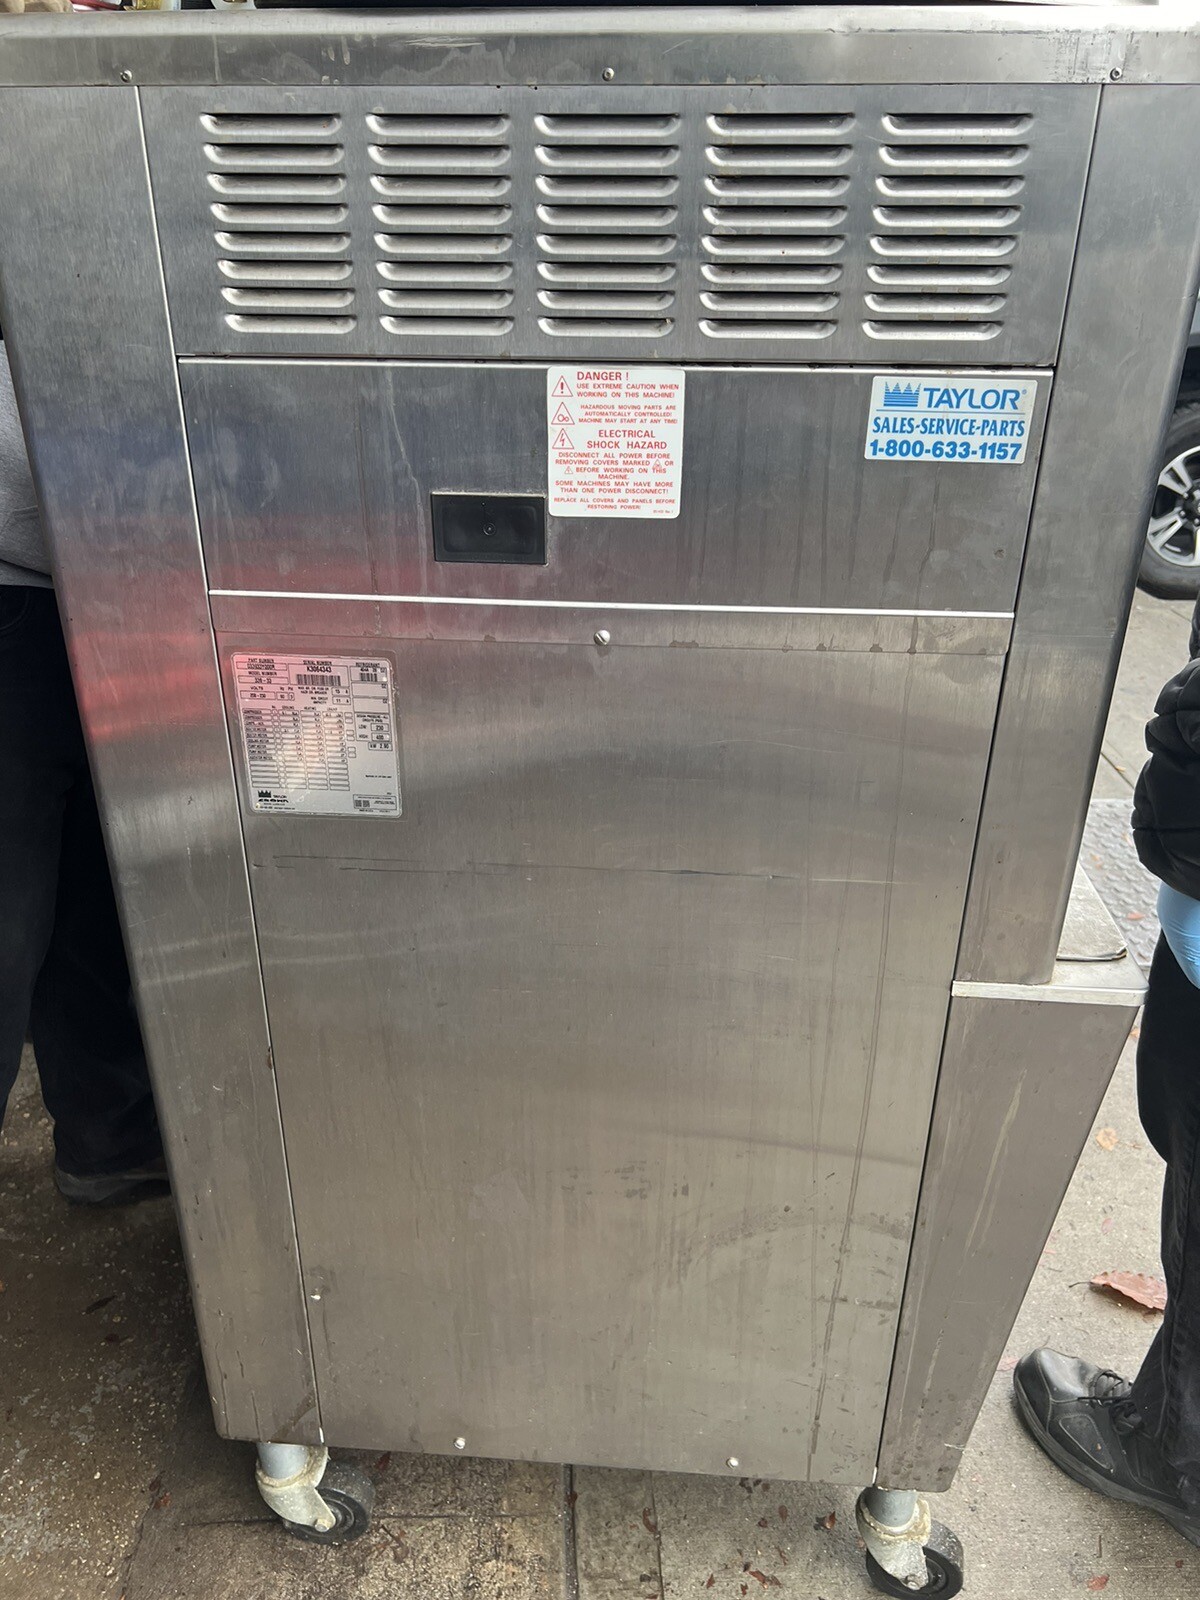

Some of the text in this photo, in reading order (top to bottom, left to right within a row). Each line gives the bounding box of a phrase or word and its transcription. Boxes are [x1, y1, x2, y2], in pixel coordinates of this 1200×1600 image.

[577, 372, 622, 380] DANGER
[924, 388, 1020, 410] TAYLOR
[598, 430, 656, 438] ELECTRICAL
[872, 417, 1025, 437] SALES-SERVICE-PARTS
[627, 441, 667, 449] HAZARD
[870, 439, 1022, 460] 1-800-633-1157
